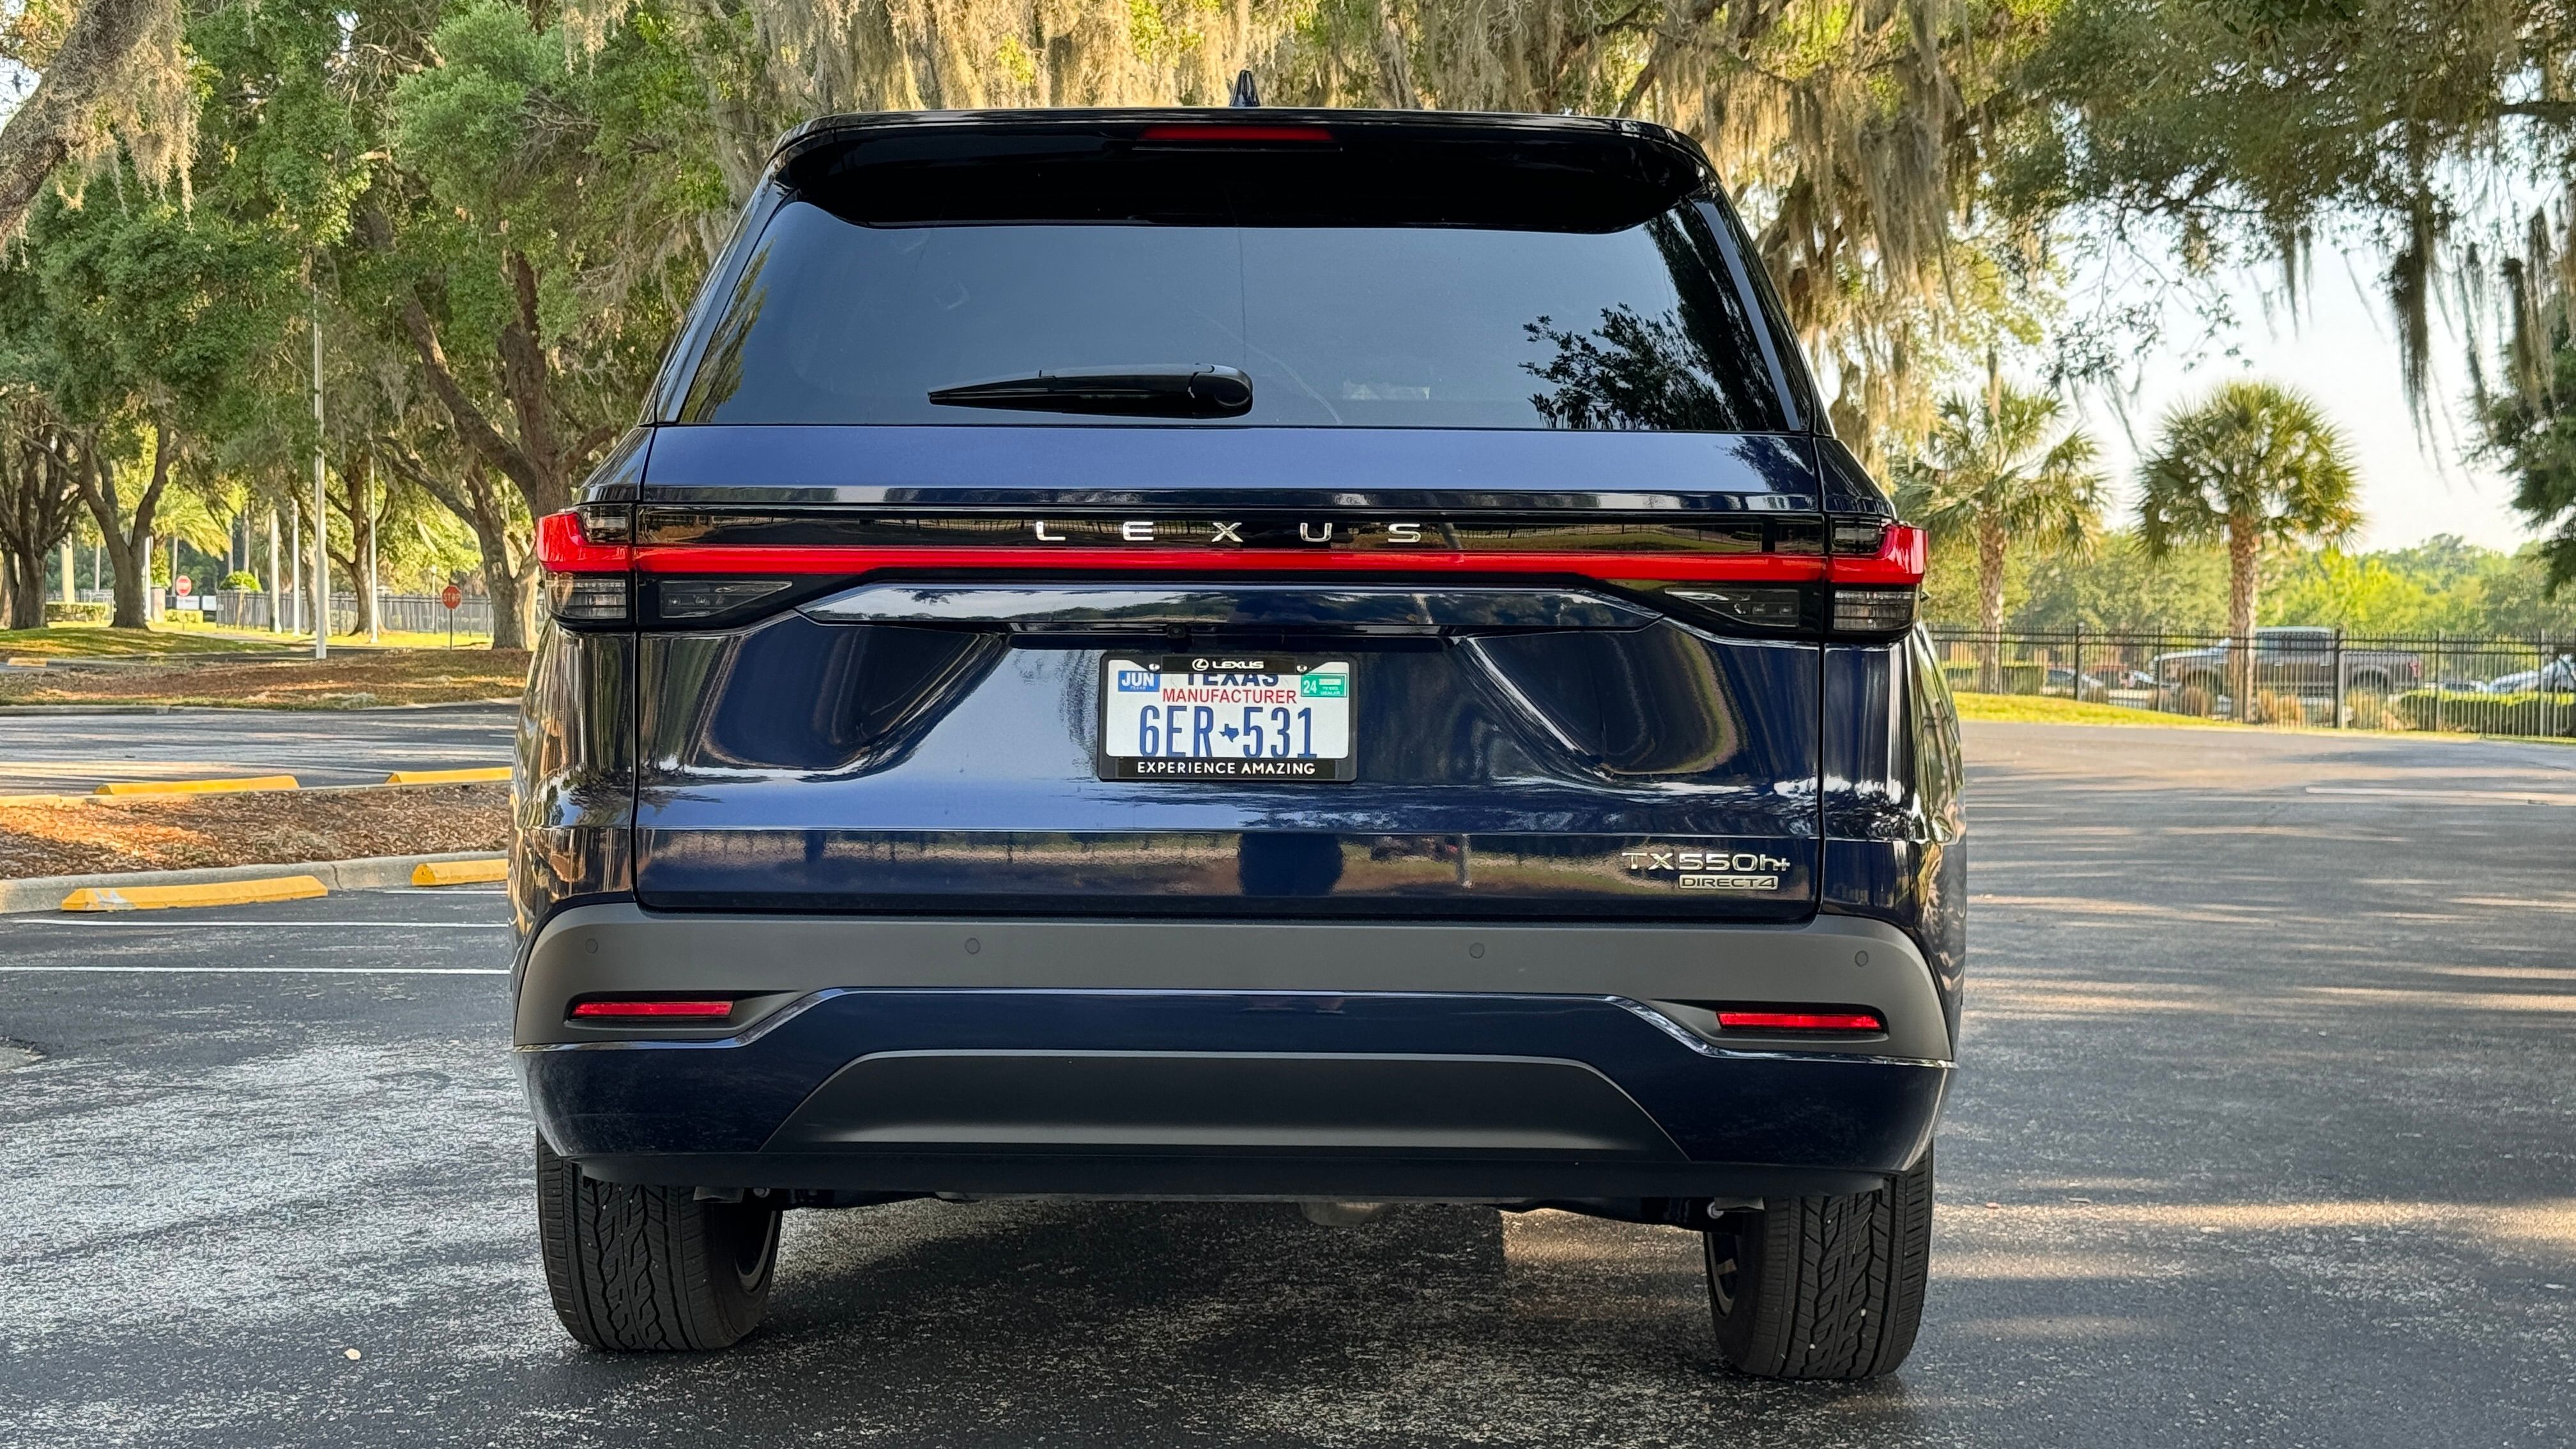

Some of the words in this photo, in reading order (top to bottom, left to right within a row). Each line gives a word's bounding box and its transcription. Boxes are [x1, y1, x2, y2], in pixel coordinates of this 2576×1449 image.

[1036, 521, 1421, 542] LEXUS
[443, 593, 461, 602] STOP
[1213, 661, 1264, 669] LEXUS
[1121, 672, 1154, 687] JUN
[1303, 680, 1317, 694] 24
[1163, 689, 1297, 703] MANUFACTURER
[1137, 762, 1236, 774] EXPERIENCE
[1241, 762, 1316, 774] AMAZING
[1682, 877, 1777, 888] DIRECT4
